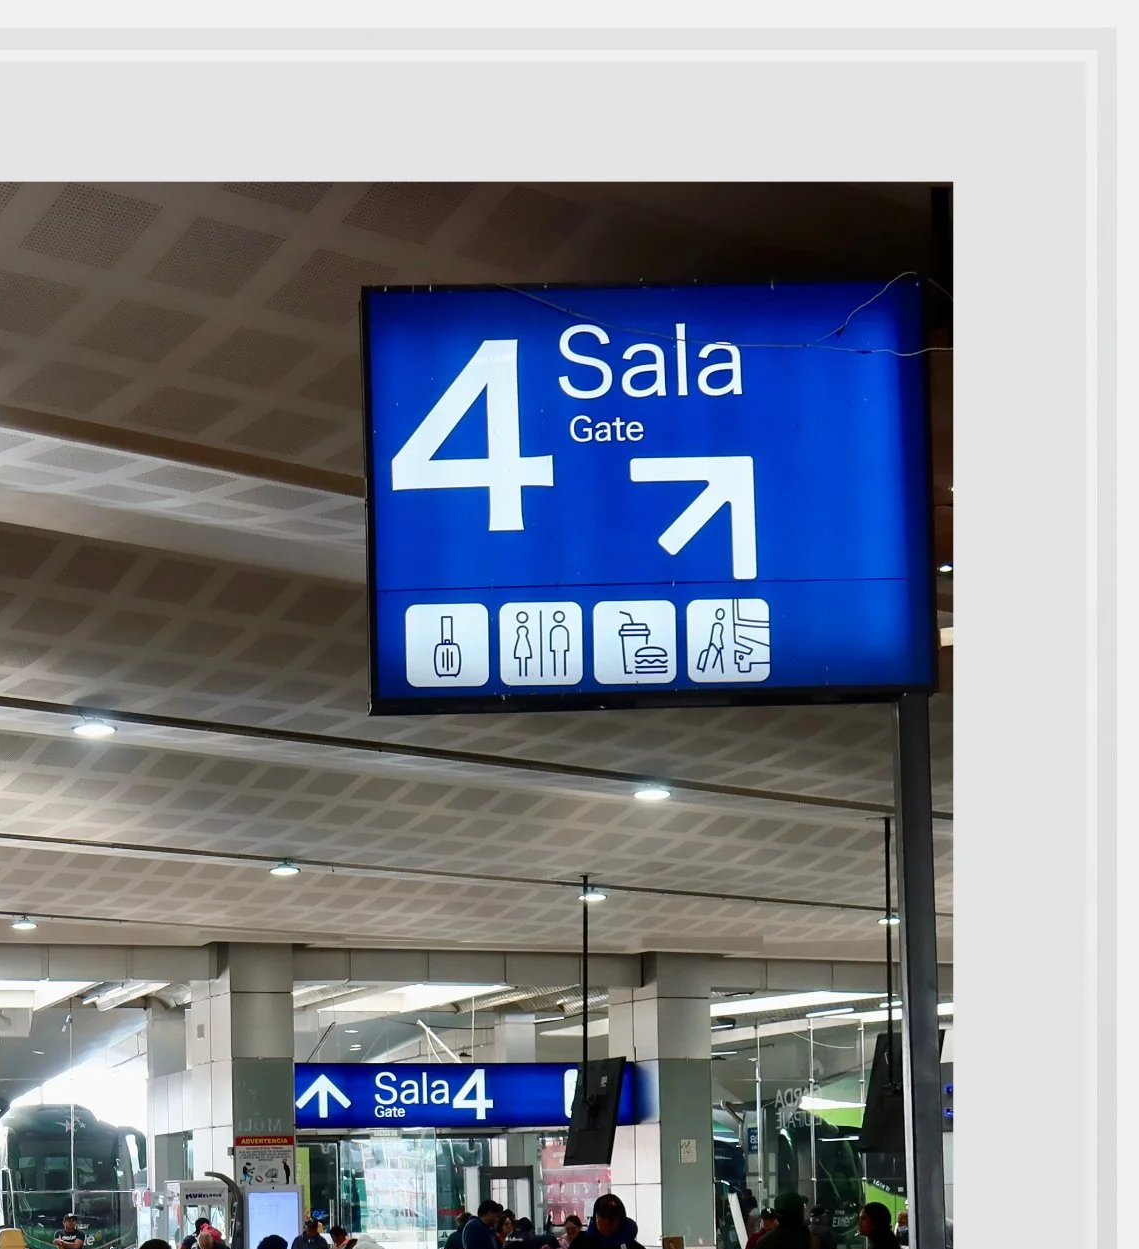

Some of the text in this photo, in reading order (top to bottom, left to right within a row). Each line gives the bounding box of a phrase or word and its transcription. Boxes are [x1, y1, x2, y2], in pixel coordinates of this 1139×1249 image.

[391, 322, 743, 531] 4 Sala
[569, 416, 645, 443] Gate
[374, 1069, 493, 1120] Sala 4
[374, 1105, 406, 1118] Gate
